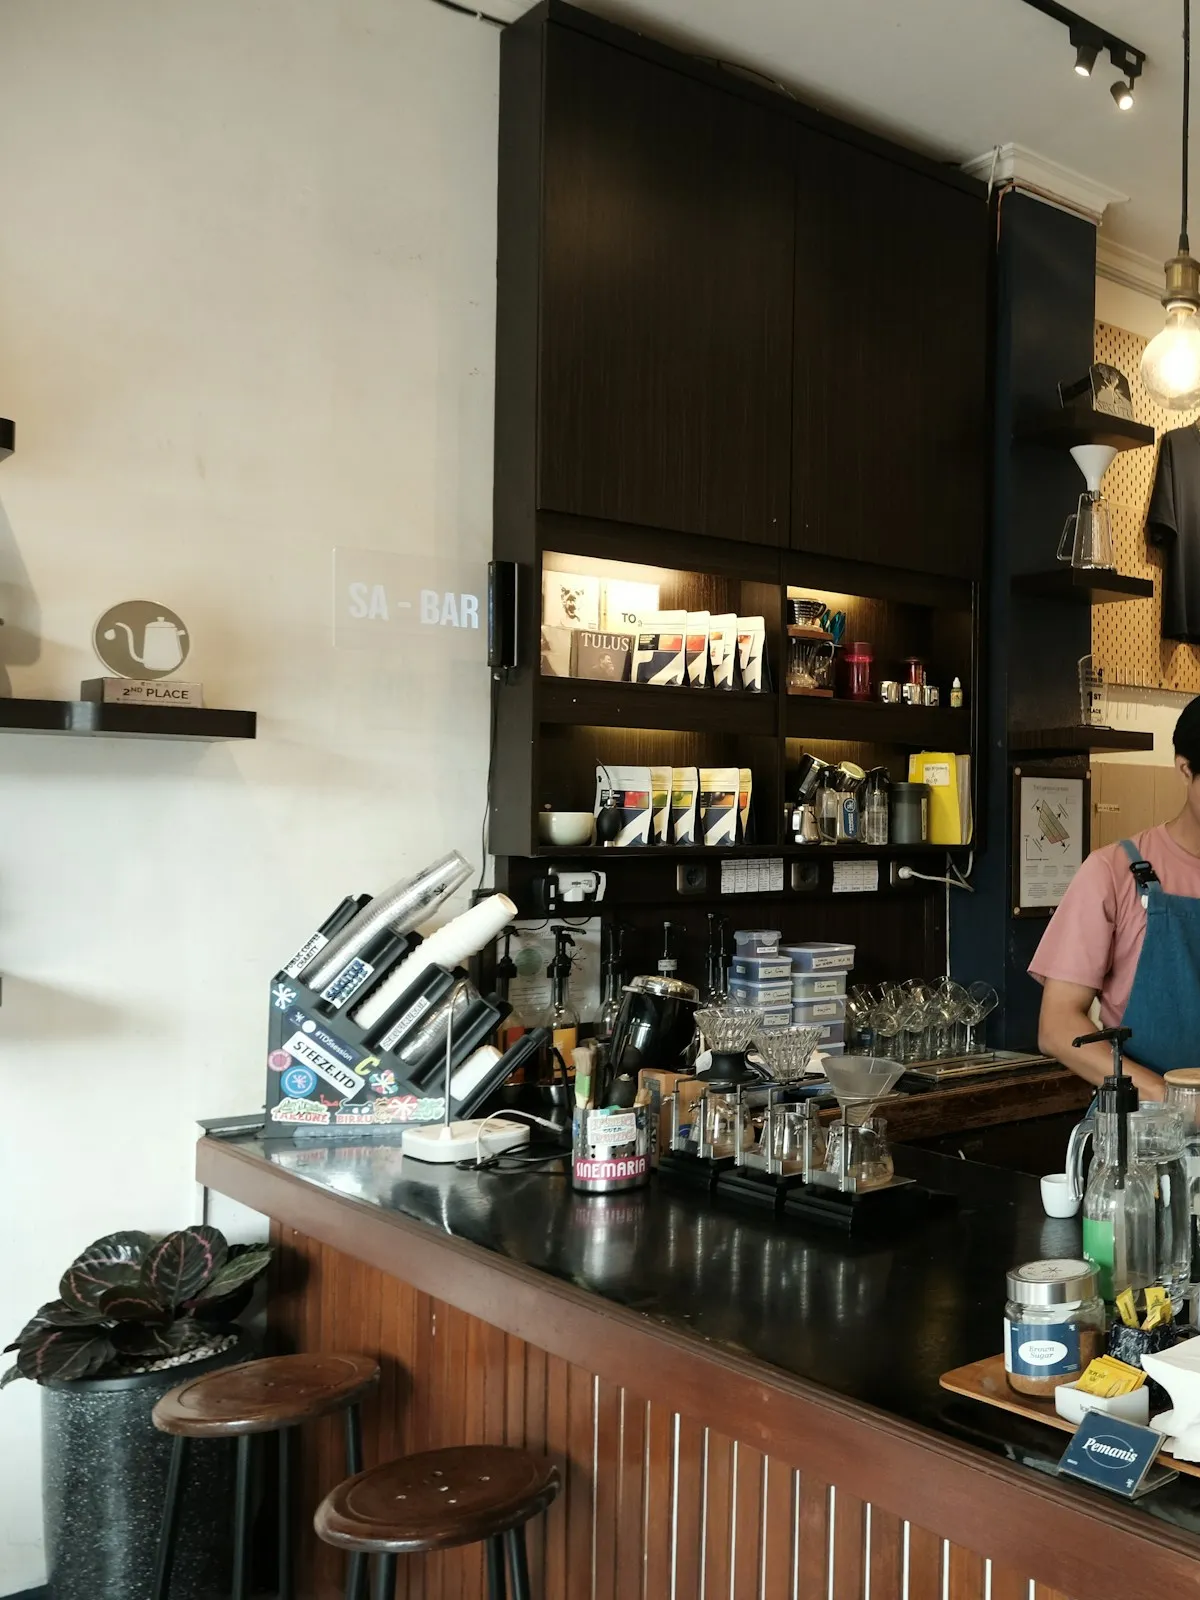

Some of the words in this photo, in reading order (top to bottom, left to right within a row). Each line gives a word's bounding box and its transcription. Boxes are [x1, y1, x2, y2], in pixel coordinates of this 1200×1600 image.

[348, 582, 389, 621] SA
[421, 589, 479, 629] BAR
[581, 632, 630, 651] TULUS
[146, 688, 190, 699] PLACE
[297, 945, 319, 969] CHARITY
[293, 1041, 356, 1089] STEEZE.LTD
[1082, 1437, 1138, 1462] Pemanis
